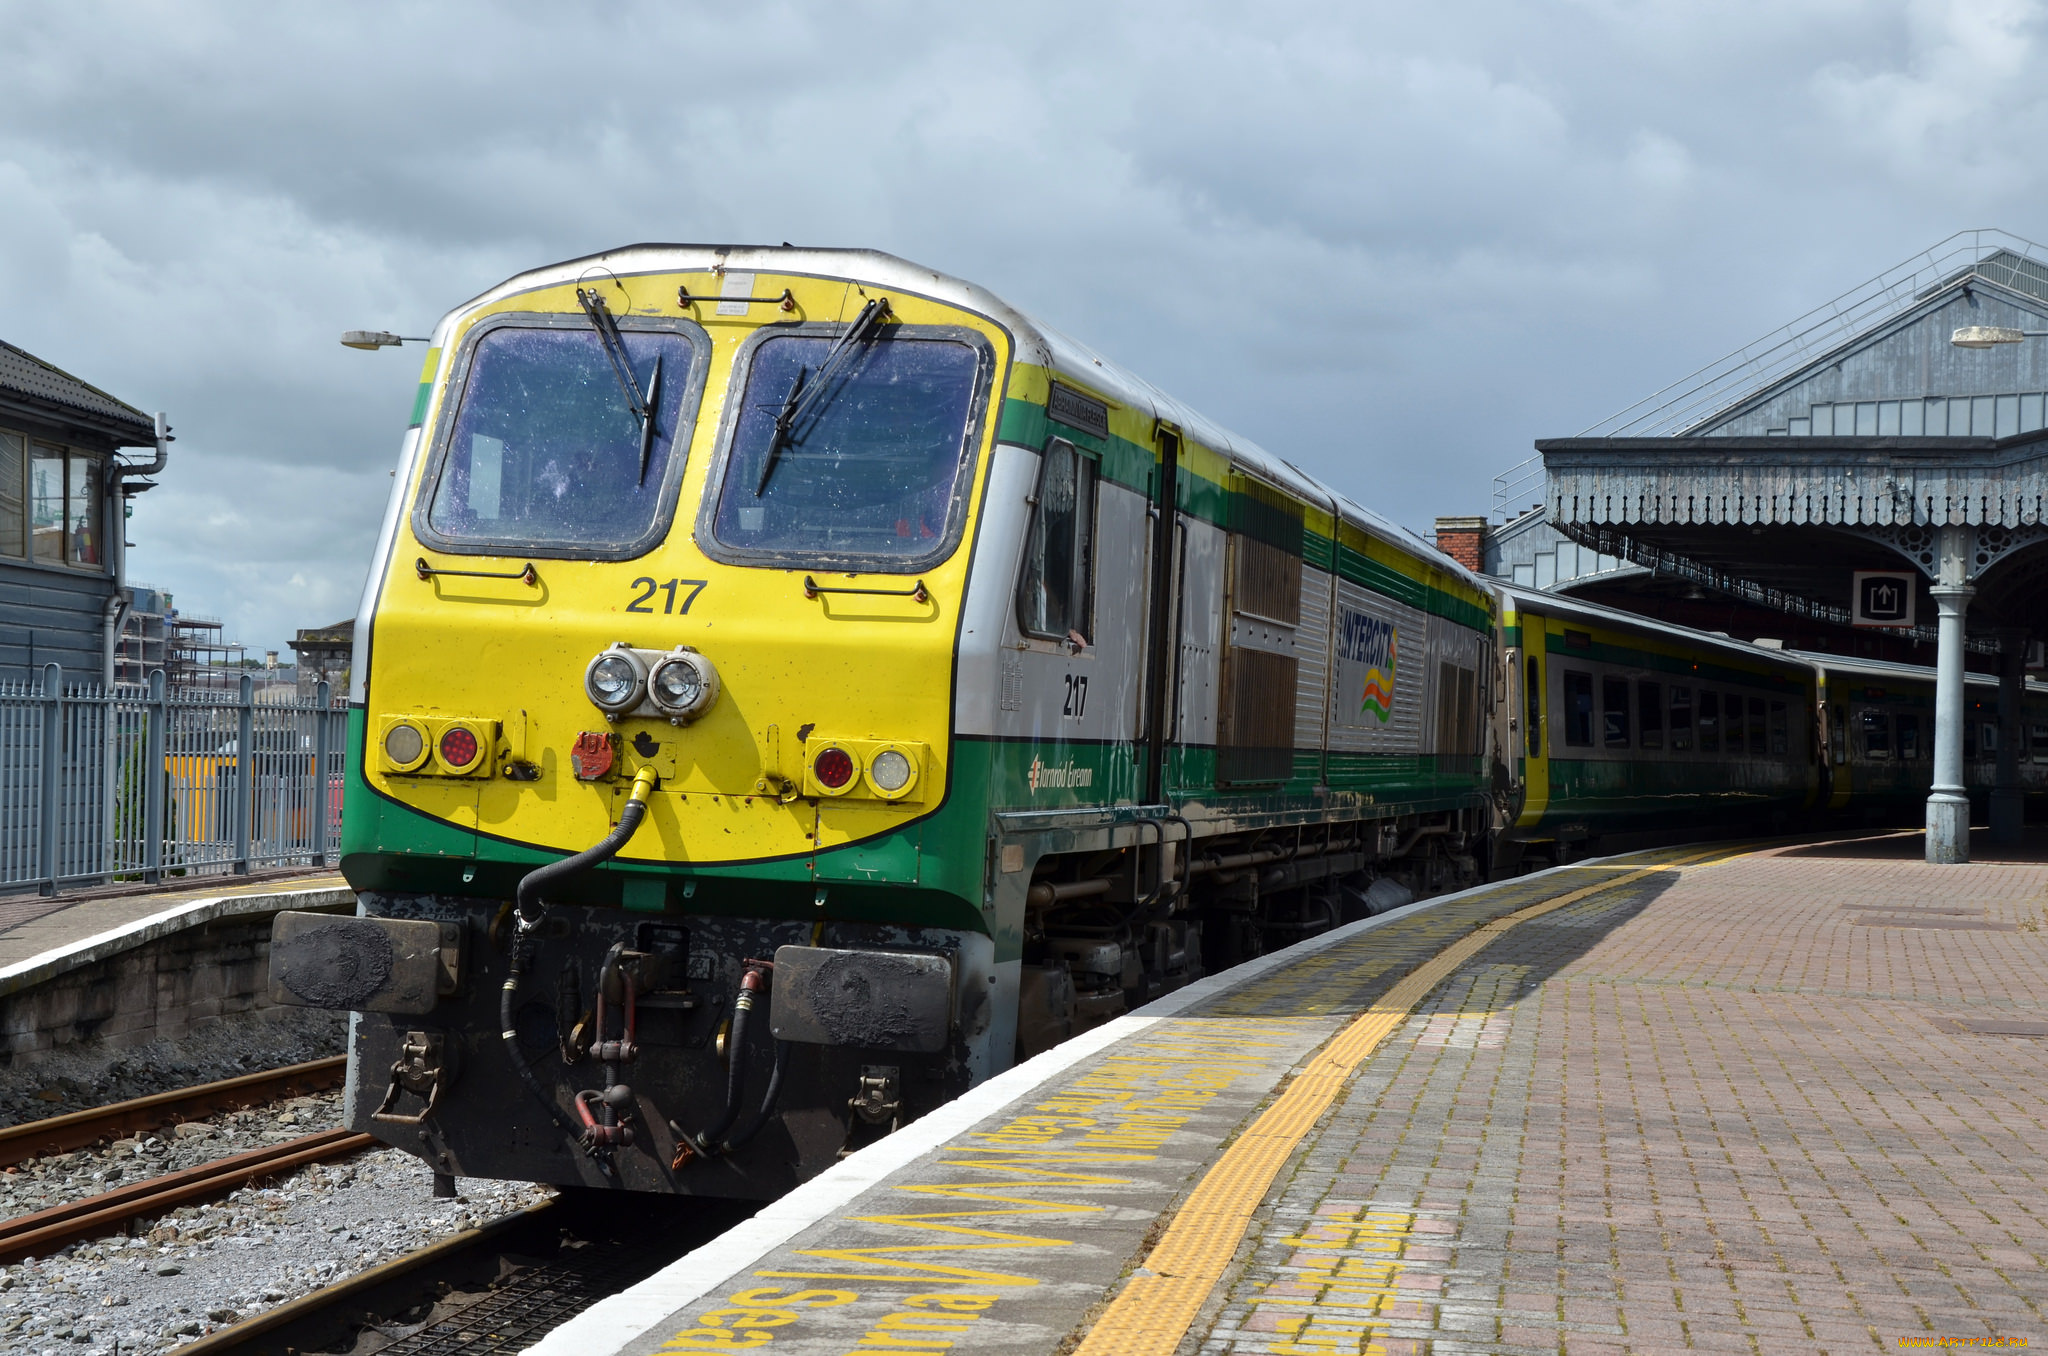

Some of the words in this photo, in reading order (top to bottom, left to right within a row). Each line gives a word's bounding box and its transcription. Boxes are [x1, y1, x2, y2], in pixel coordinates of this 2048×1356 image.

[626, 576, 708, 615] 217
[1341, 610, 1393, 668] INTERCITY
[1064, 673, 1088, 719] 217
[1039, 760, 1067, 788] Iarnród
[1068, 753, 1093, 788] Éireann
[1074, 1061, 1173, 1090] Mind
[1155, 1066, 1259, 1089] Gap
[1034, 1090, 1136, 1114] The
[1122, 1089, 1218, 1111] The
[970, 1115, 1098, 1145] Gap
[1074, 1113, 1190, 1150] Mind
